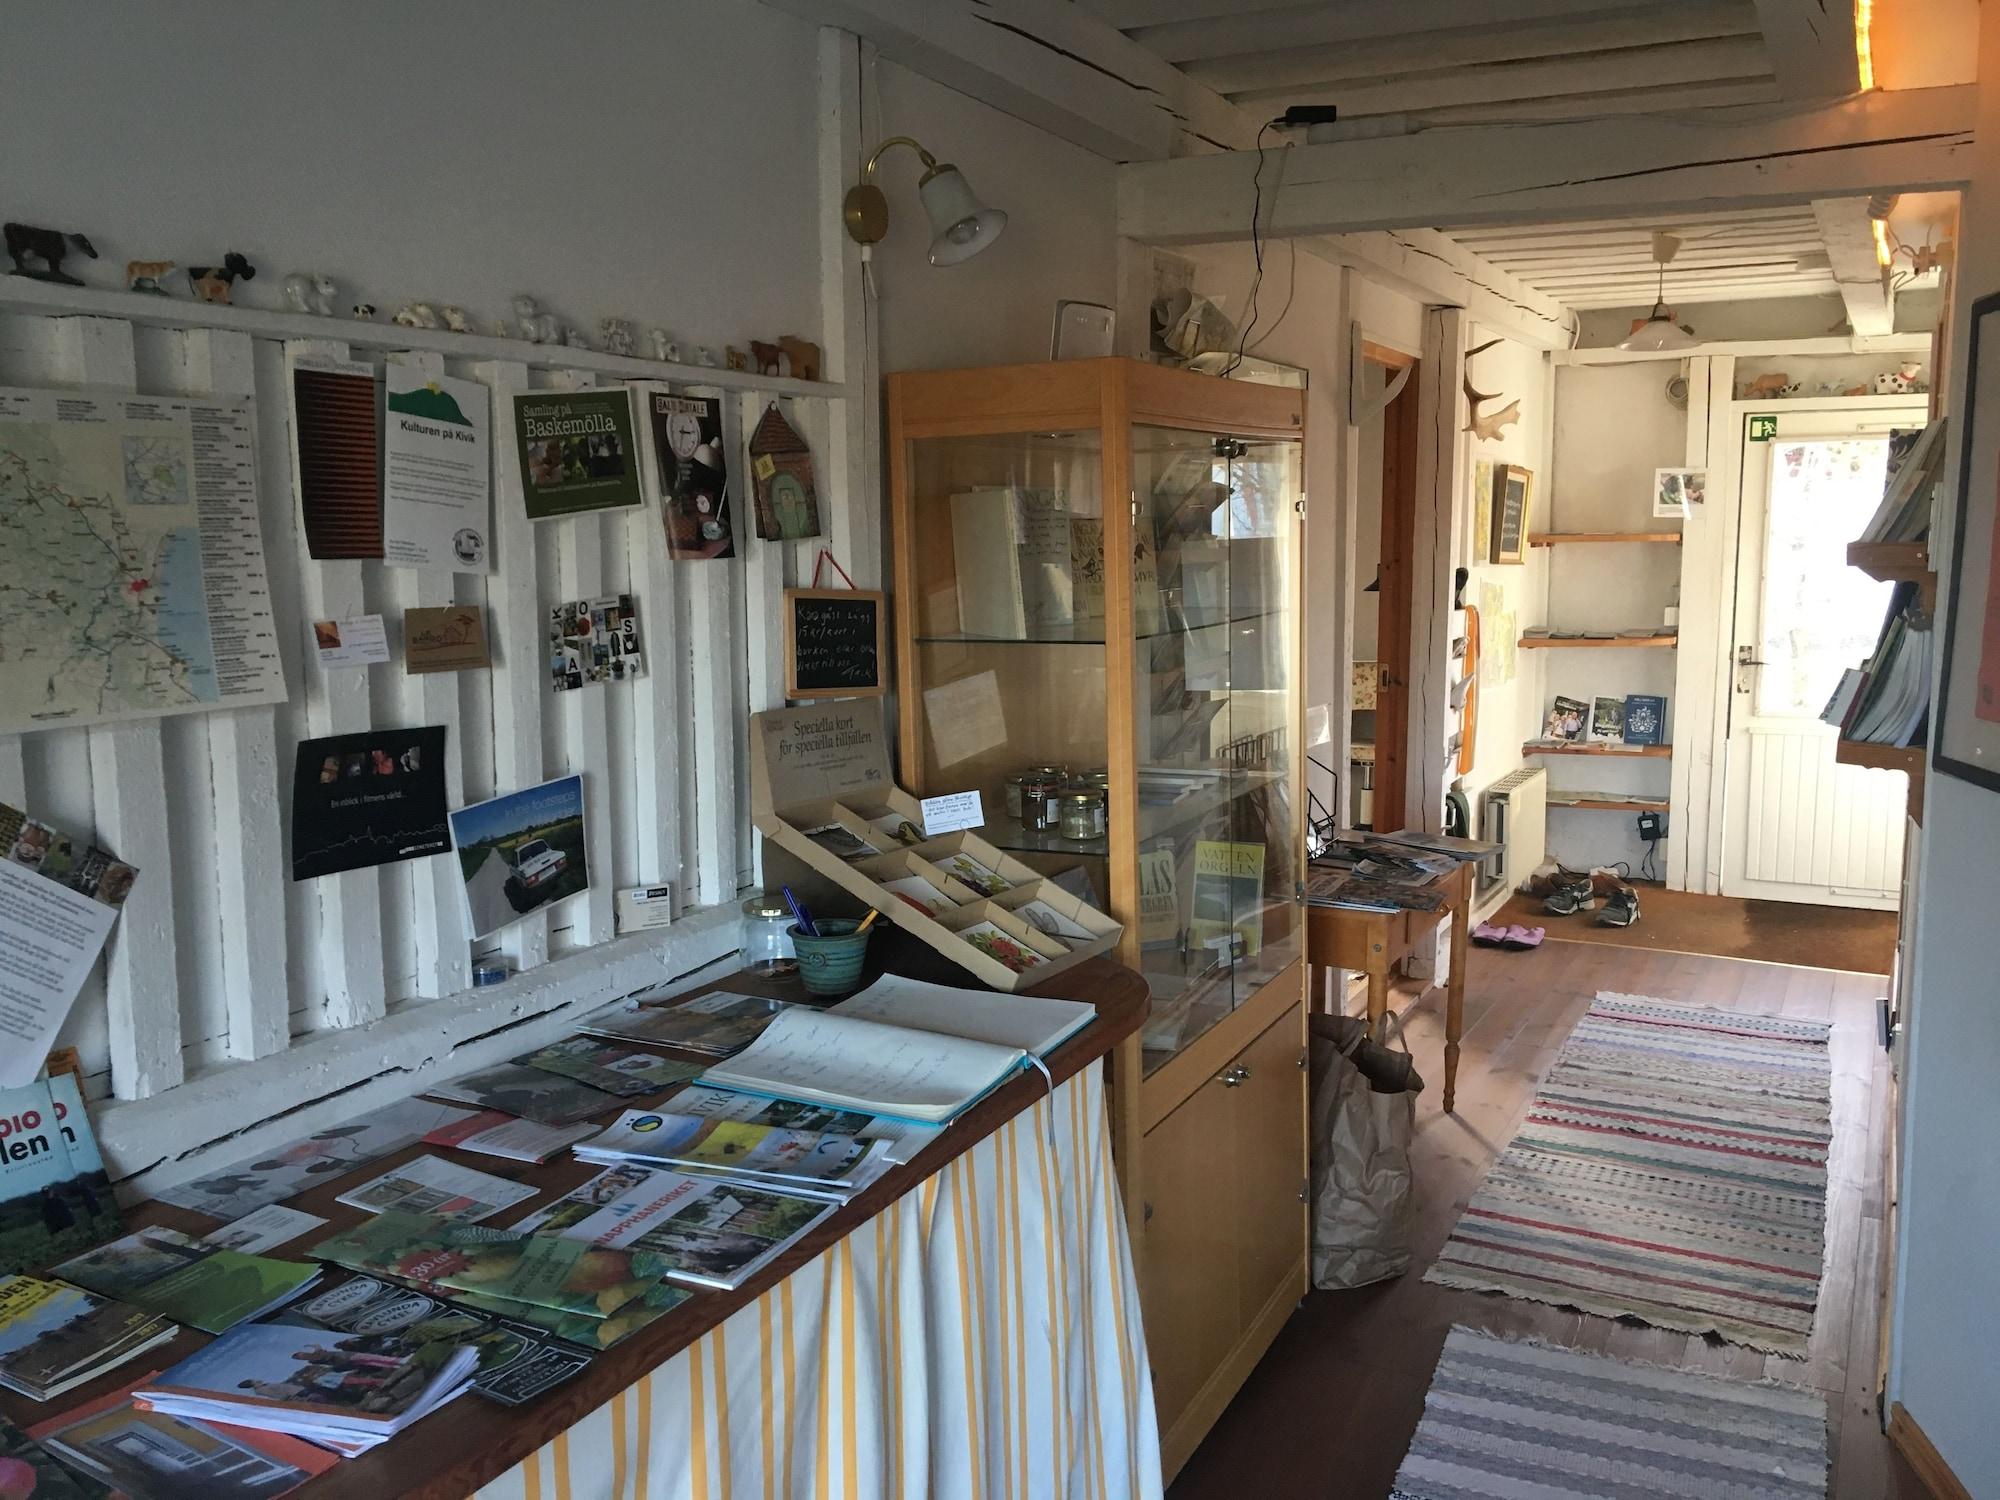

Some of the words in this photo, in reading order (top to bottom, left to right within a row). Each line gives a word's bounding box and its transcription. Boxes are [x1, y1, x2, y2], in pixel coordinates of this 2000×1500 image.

[523, 404, 560, 418] Samling
[560, 402, 572, 416] på
[400, 419, 440, 436] Kulturen
[442, 428, 454, 441] på
[455, 430, 476, 444] Kivik
[525, 414, 616, 437] Baskemölla
[794, 717, 834, 738] Speciella
[835, 715, 853, 730] kort
[779, 739, 793, 760] för
[795, 736, 833, 756] speciella
[835, 732, 872, 751] tillfällen
